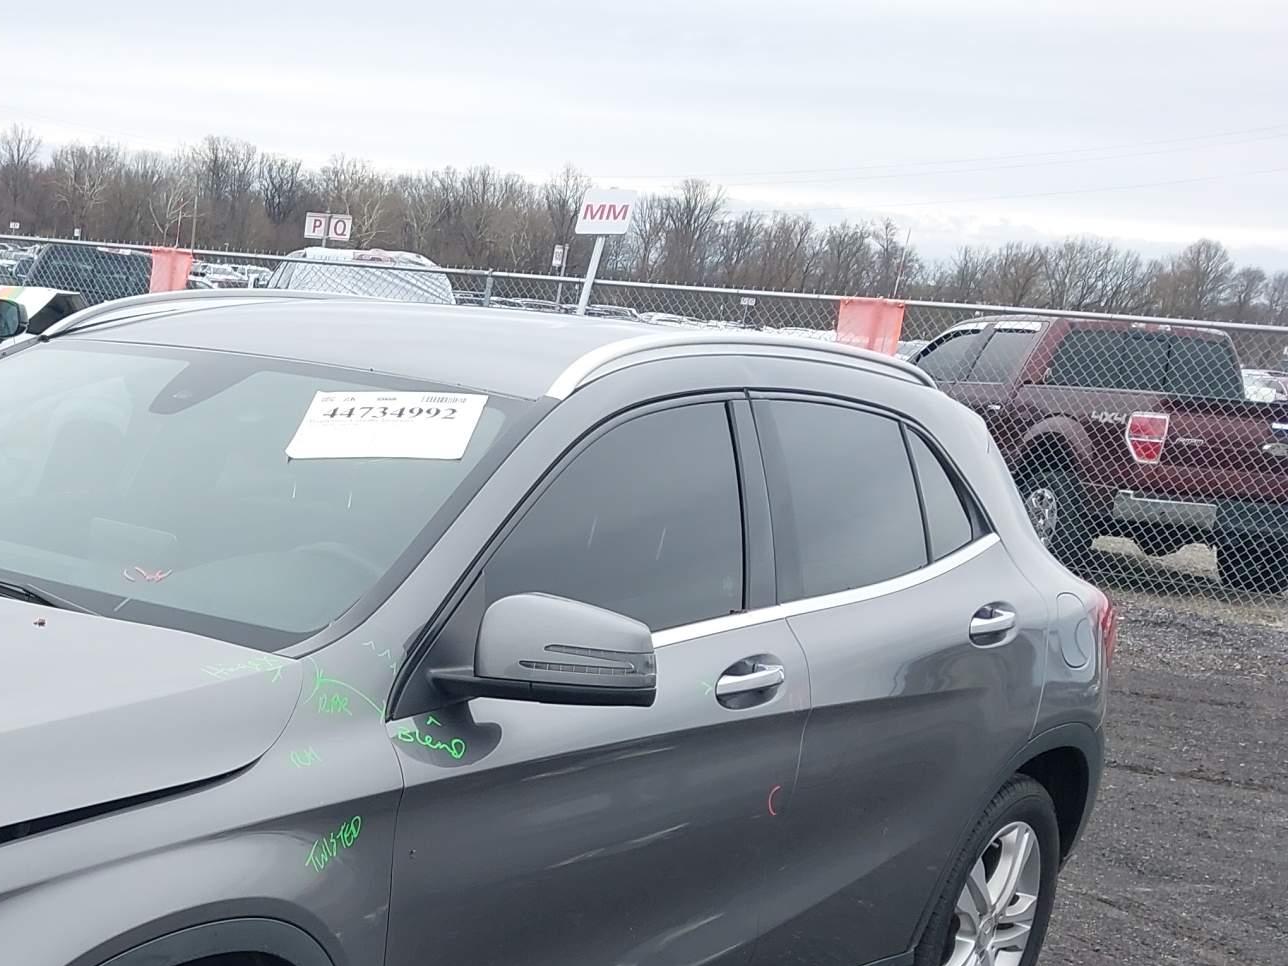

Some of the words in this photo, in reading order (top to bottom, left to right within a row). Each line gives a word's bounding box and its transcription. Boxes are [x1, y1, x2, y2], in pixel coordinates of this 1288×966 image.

[583, 203, 629, 220] MM
[312, 218, 323, 233] P
[333, 219, 347, 236] Q
[323, 405, 458, 420] 44734992
[305, 815, 362, 872] TWISTED
